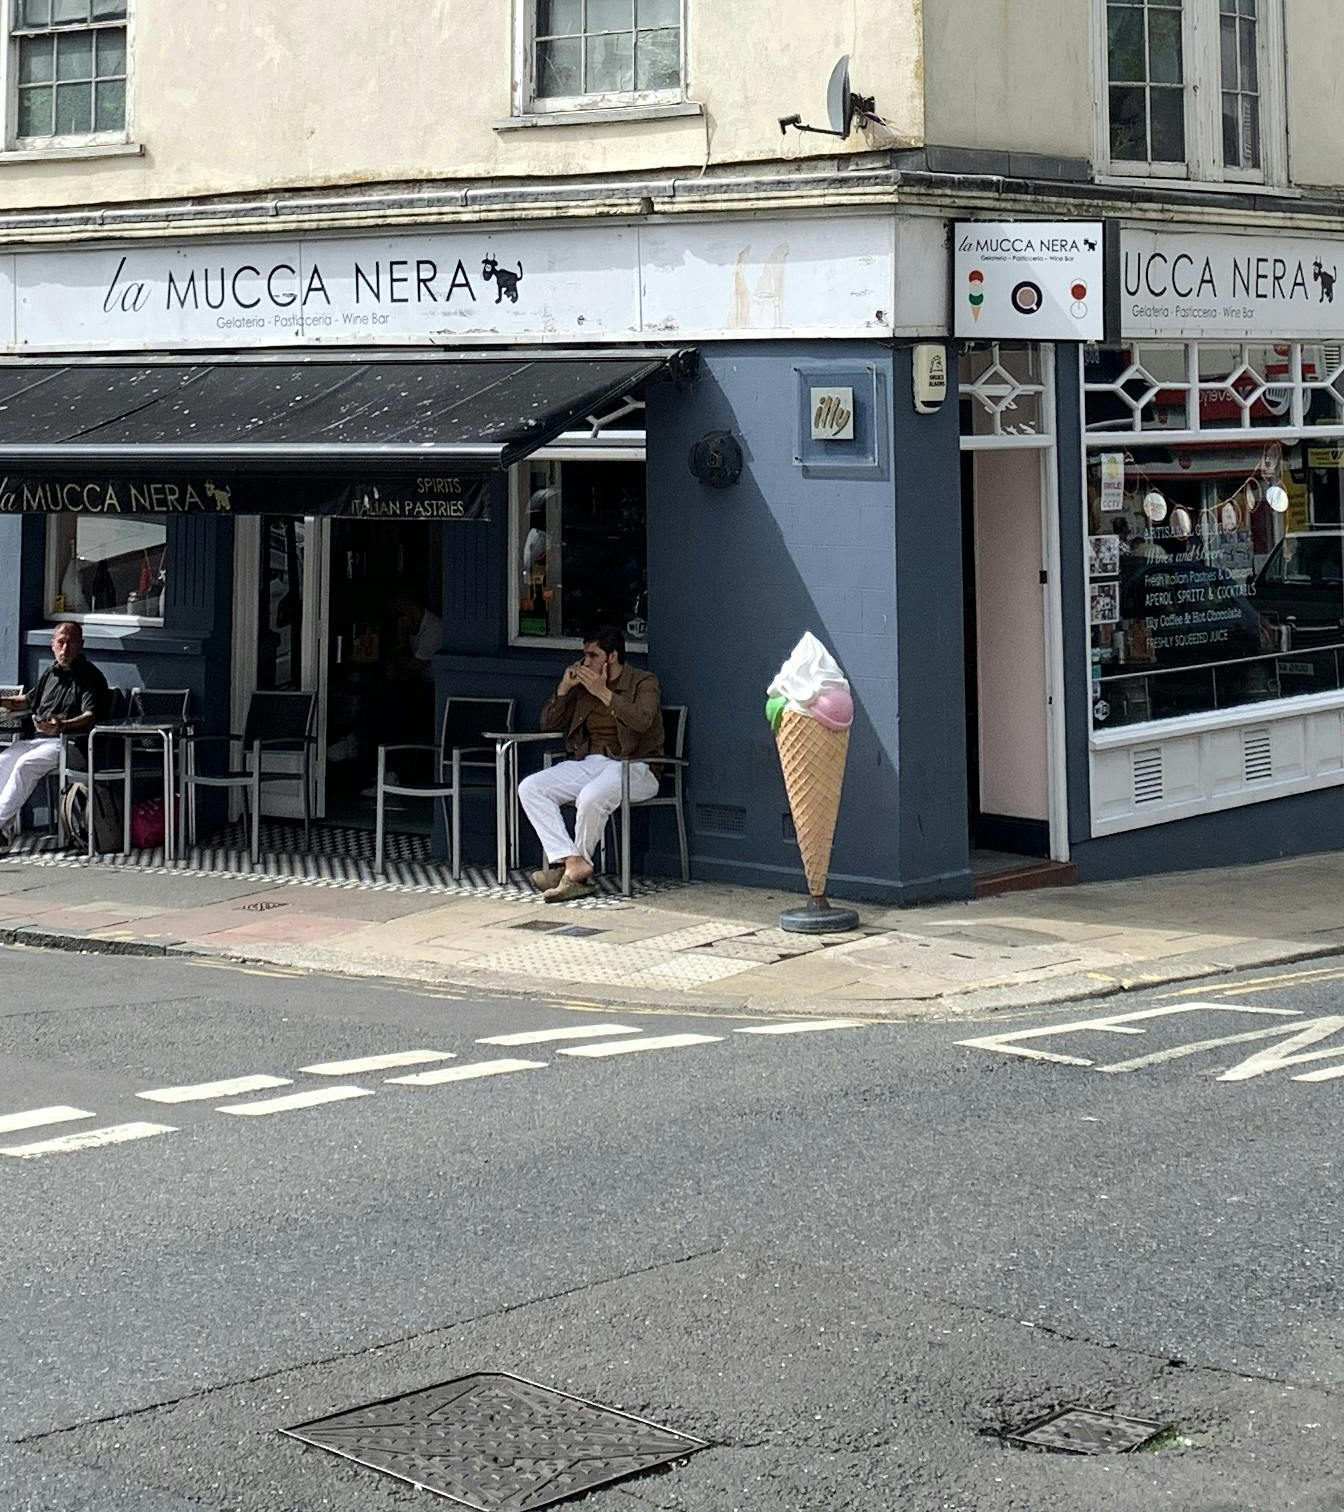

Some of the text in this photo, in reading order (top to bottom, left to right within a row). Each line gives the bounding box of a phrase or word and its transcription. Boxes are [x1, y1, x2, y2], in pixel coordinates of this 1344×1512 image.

[959, 235, 1081, 252] la MUCCA NERA
[1125, 251, 1309, 300] UCCA NERA
[103, 257, 476, 313] la MUCCA NERA
[216, 316, 265, 329] Gelateria
[274, 313, 332, 327] Pasticceria
[342, 312, 369, 324] Wine
[371, 312, 390, 324] Bar
[1132, 304, 1169, 318] Gelateria
[1175, 305, 1217, 319] Pasticceria
[1223, 306, 1241, 319] Wine
[1242, 306, 1255, 319] Bar
[814, 395, 851, 437] illy
[416, 477, 461, 493] SPIRITS
[23, 483, 121, 512] MUCCA
[130, 483, 205, 512] NERA
[351, 499, 465, 516] ITALIAN PASTRIES
[1176, 544, 1196, 562] and
[1144, 574, 1165, 587] Fresh
[1145, 583, 1256, 606] APEROL SPRITZ & COCKTAILS
[1160, 613, 1183, 627] Coffee
[1184, 612, 1191, 624] &
[1192, 611, 1205, 623] Hot
[1207, 608, 1242, 622] Chocolate
[1146, 629, 1228, 649] FRESHLY SQUEEZED JUICE
